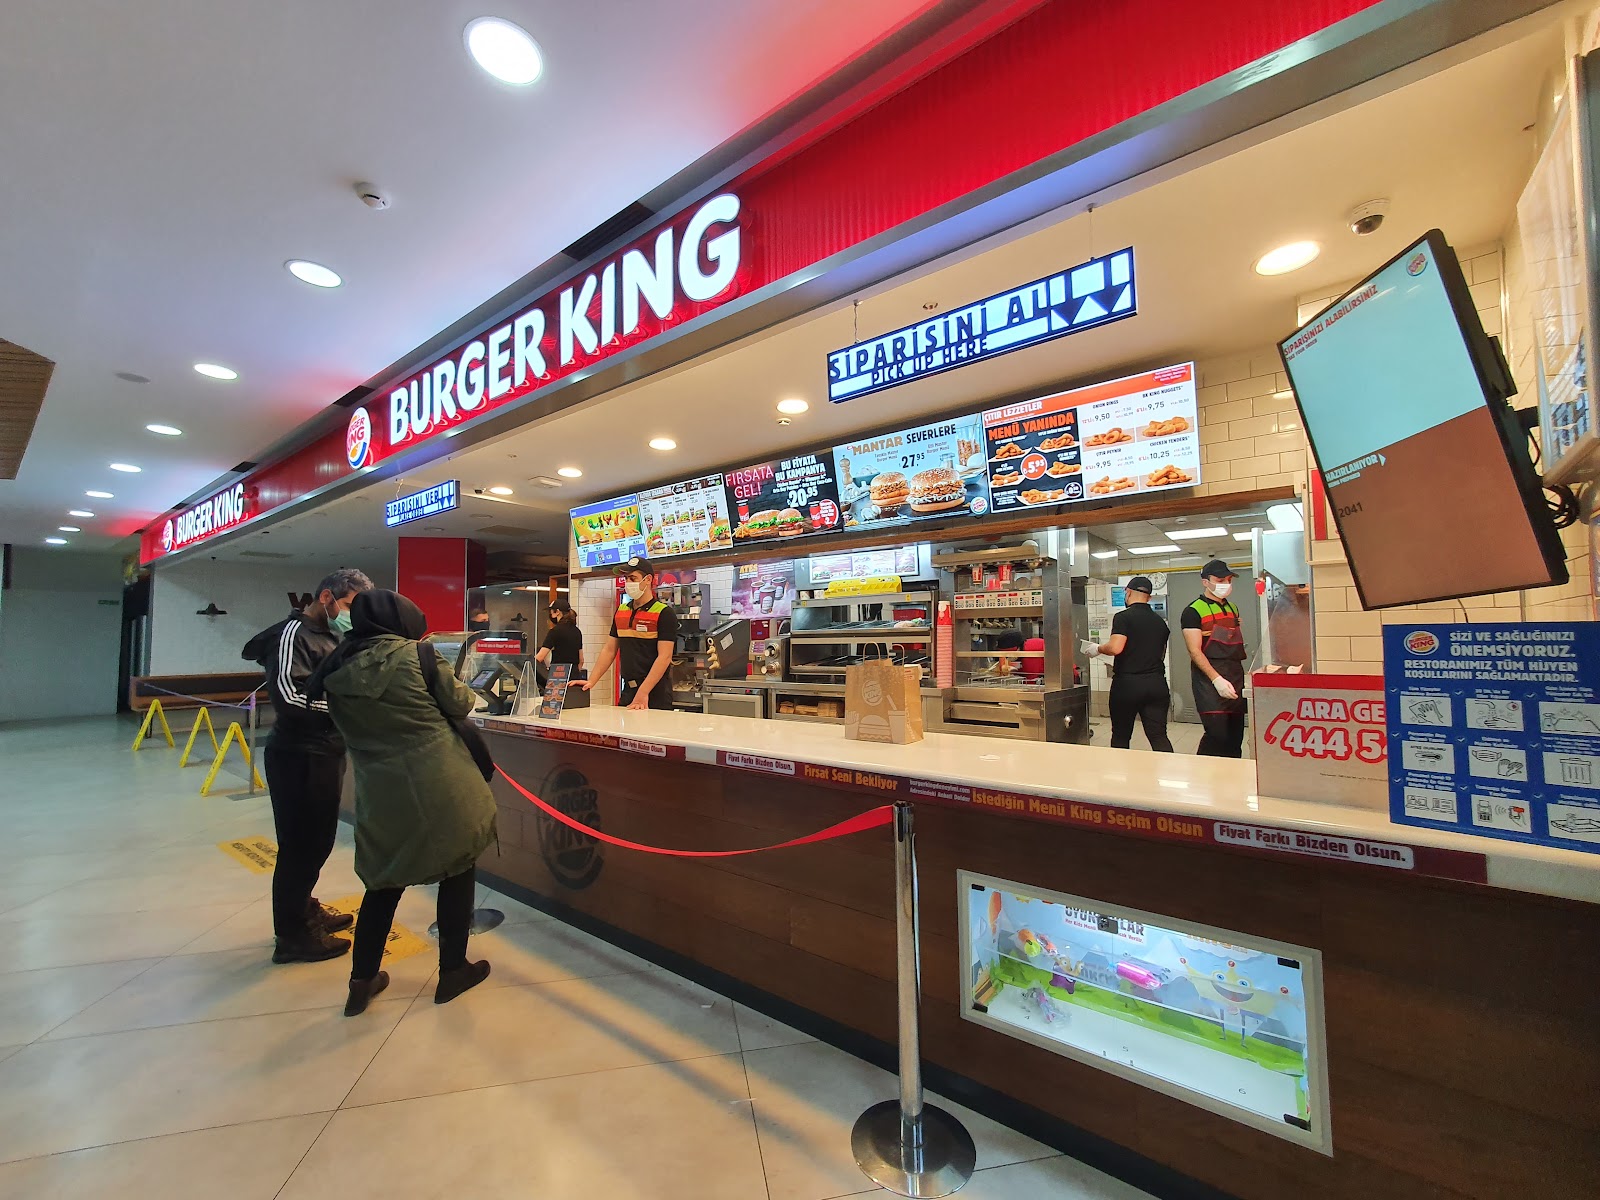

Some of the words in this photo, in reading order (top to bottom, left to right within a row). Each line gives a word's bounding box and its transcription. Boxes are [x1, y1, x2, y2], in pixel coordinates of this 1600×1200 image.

[390, 308, 546, 446] BURGER
[560, 193, 741, 367] KING
[944, 338, 988, 364] HERE
[1003, 401, 1043, 418] LEZZETLER
[988, 422, 1020, 441] MENÜ
[1022, 412, 1075, 434] YANINDA
[852, 436, 903, 456] MANTAR
[906, 424, 957, 445] SEVERLERE
[780, 460, 792, 471] BU
[793, 454, 817, 469] FİYATA
[1149, 450, 1170, 460] 10,25
[725, 465, 774, 487] FIRSATA
[775, 472, 786, 482] BU
[786, 463, 826, 480] KAMPANYA
[1325, 454, 1378, 483] HAZIRLANIYOR
[734, 482, 762, 499] GEL!
[176, 500, 213, 544] BURGER
[214, 483, 244, 528] KING
[1338, 502, 1363, 518] 2041
[1410, 640, 1434, 650] KING
[1450, 629, 1472, 642] SİZİ
[1475, 631, 1492, 642] VE
[1494, 629, 1575, 643] SAĞLIĞINIZI
[1450, 642, 1576, 658] ÖNEMSİYORUZ.
[1404, 659, 1493, 671] RESTORANIMIZ
[1495, 659, 1524, 671] TÜM
[1528, 659, 1578, 672] HİJYEN
[1405, 670, 1473, 680] KOŞULLARINI
[1475, 671, 1579, 683] SAĞLAMAKTADIR.
[1299, 699, 1348, 721] ARA
[1352, 701, 1387, 724] GE
[1284, 726, 1348, 758] 444
[1359, 731, 1388, 761] 5
[755, 757, 774, 768] Bizden
[831, 768, 852, 784] Seni
[855, 771, 898, 791] Bekliyor
[1029, 798, 1065, 818] Menü
[1070, 805, 1102, 824] King
[1107, 809, 1151, 830] Seçim
[1156, 816, 1203, 837] Olsun
[1219, 824, 1251, 841] Fiyat
[1255, 829, 1290, 846] Farkı
[1295, 835, 1348, 854] Bizden
[1354, 842, 1406, 862] Olsun.
